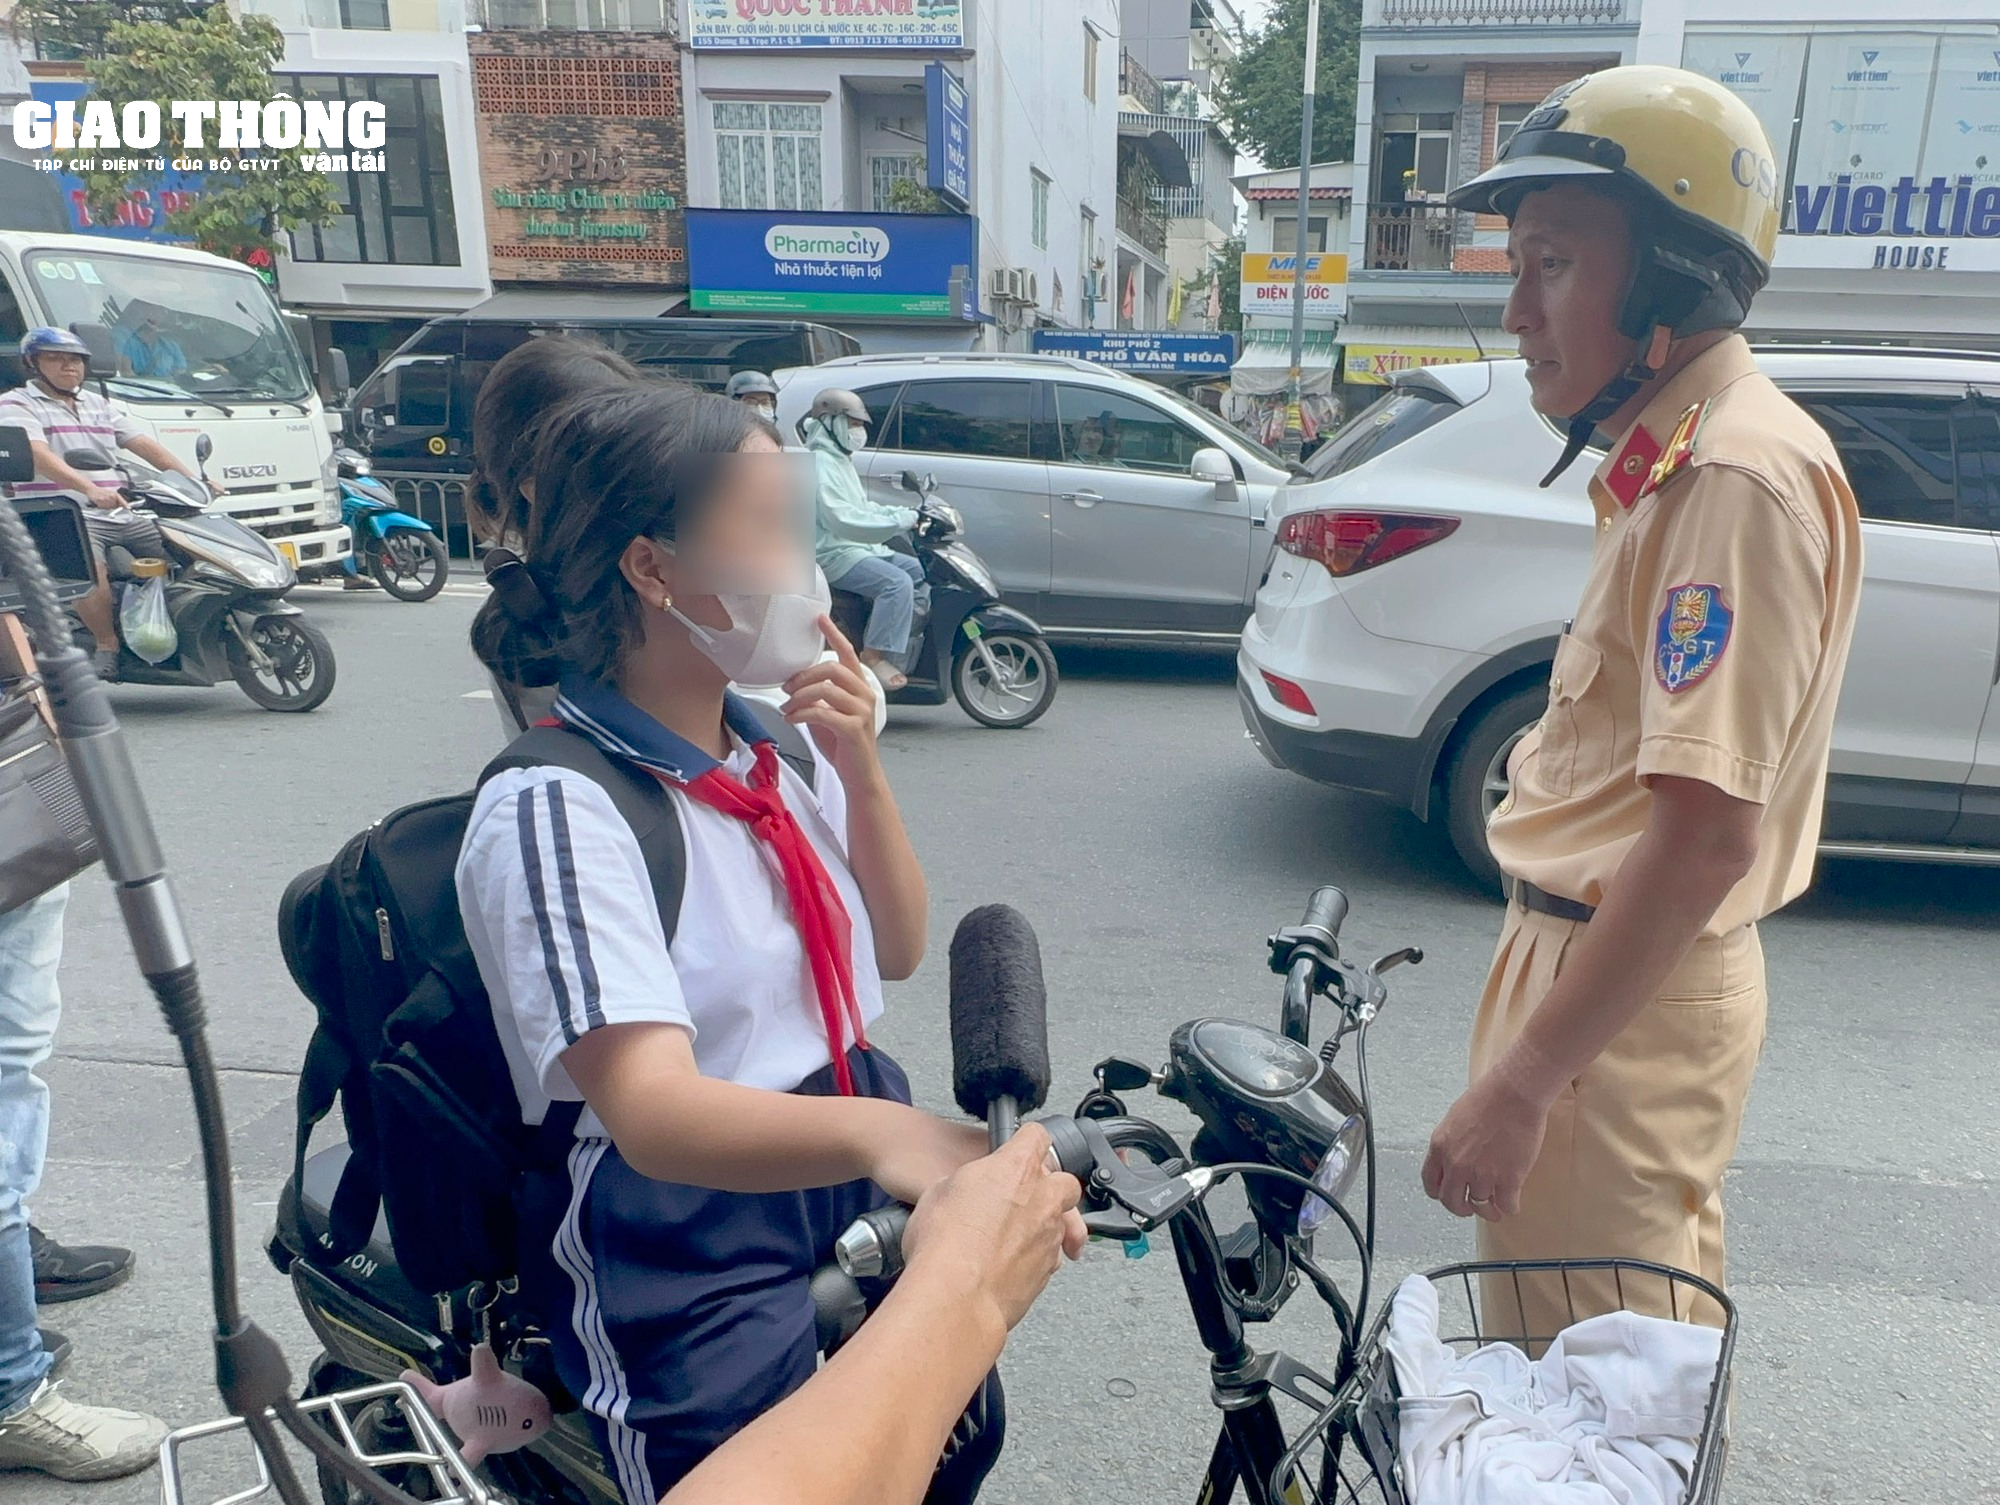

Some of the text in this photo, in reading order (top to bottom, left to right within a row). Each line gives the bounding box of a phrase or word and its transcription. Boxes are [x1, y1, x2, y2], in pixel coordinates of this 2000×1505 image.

[715, 24, 731, 34] BAY
[853, 23, 863, 34] XE
[899, 23, 914, 34] 16C
[920, 23, 936, 34] 29C
[941, 23, 958, 34] 45C
[1720, 72, 1760, 84] viettien
[1847, 71, 1889, 83] viettien
[773, 231, 881, 258] Pharmacity
[1874, 245, 1950, 269] HOUSE
[775, 262, 882, 280] Nhà thuốc tiện lợi
[1257, 284, 1330, 301] ĐIỆN ƯỚC
[1103, 338, 1161, 349] KHU PHỐ 2
[1037, 348, 1227, 364] KHU PHỐ VĂN HÓA
[286, 424, 310, 433] NMR
[223, 464, 277, 480] ISUZU
